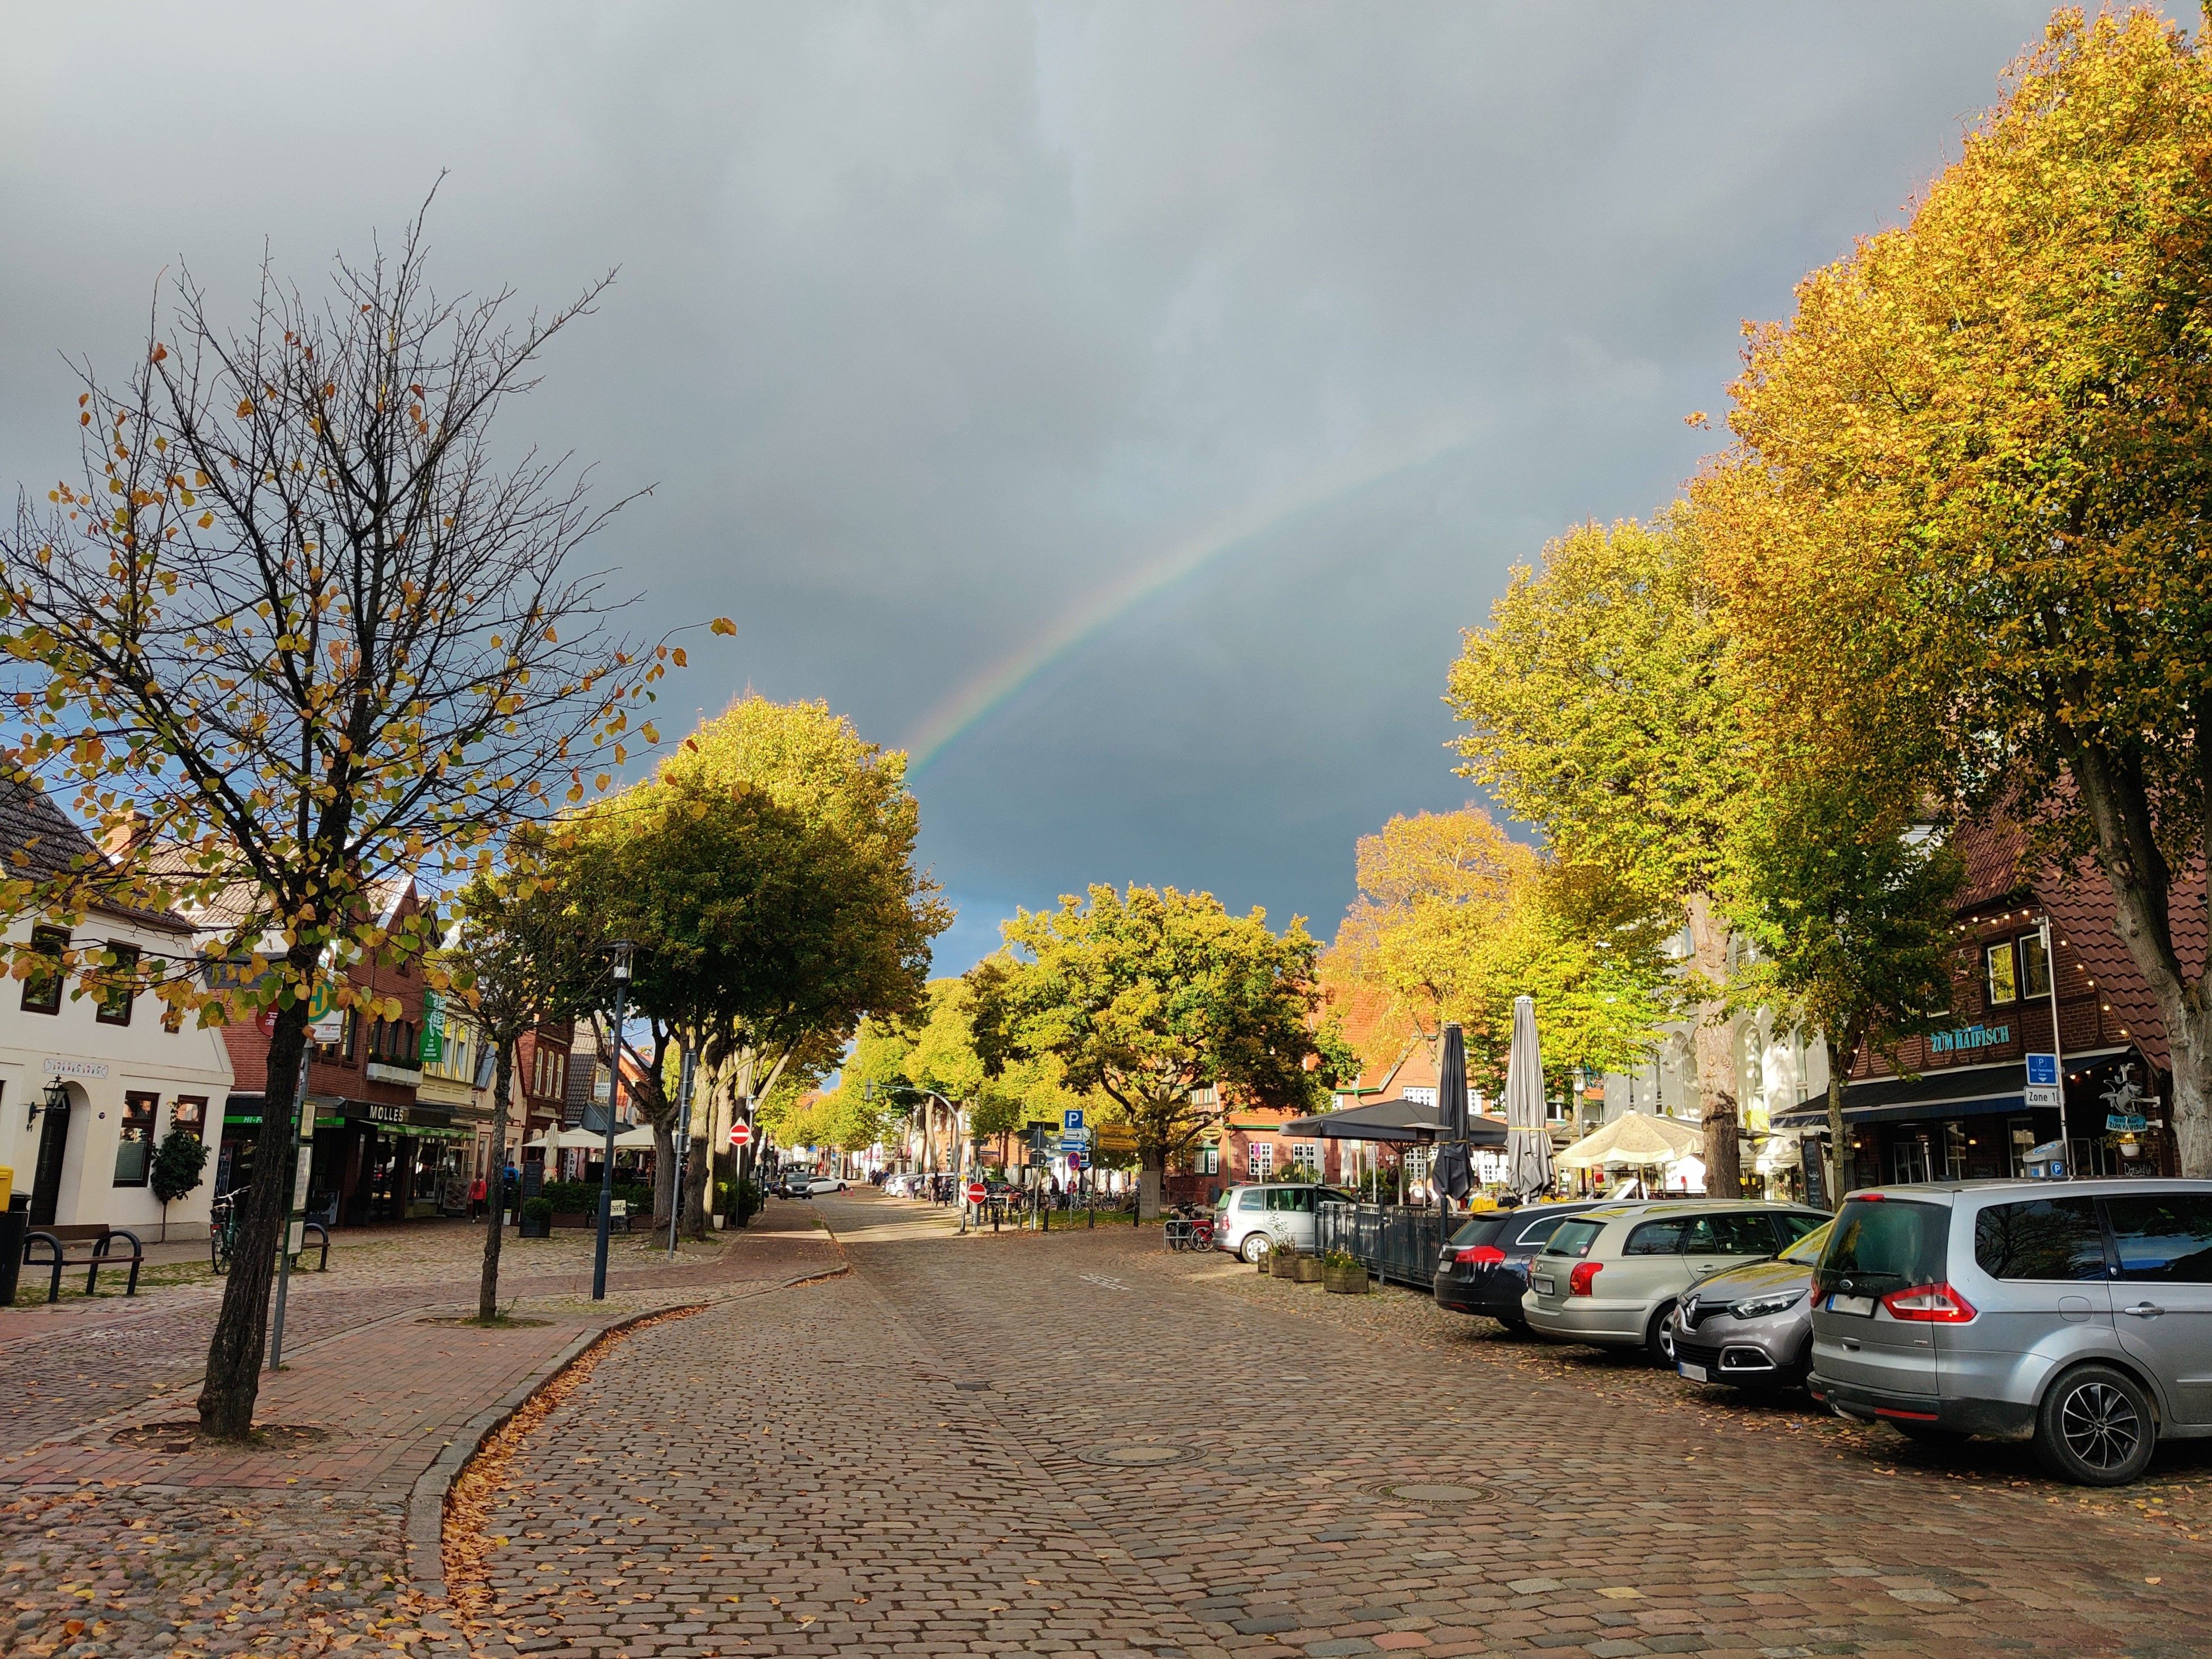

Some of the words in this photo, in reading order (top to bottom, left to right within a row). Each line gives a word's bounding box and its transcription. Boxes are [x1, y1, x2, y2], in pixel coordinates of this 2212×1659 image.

[1931, 1035, 1954, 1053] ZUM
[1955, 1025, 2010, 1049] HAIFISCH
[2029, 1092, 2048, 1102] Zone
[2051, 1092, 2056, 1102] 1
[369, 1105, 404, 1122] MOLLES
[1068, 1112, 1079, 1127] P
[2109, 1121, 2121, 1130] ZUM
[2054, 1164, 2061, 1174] P
